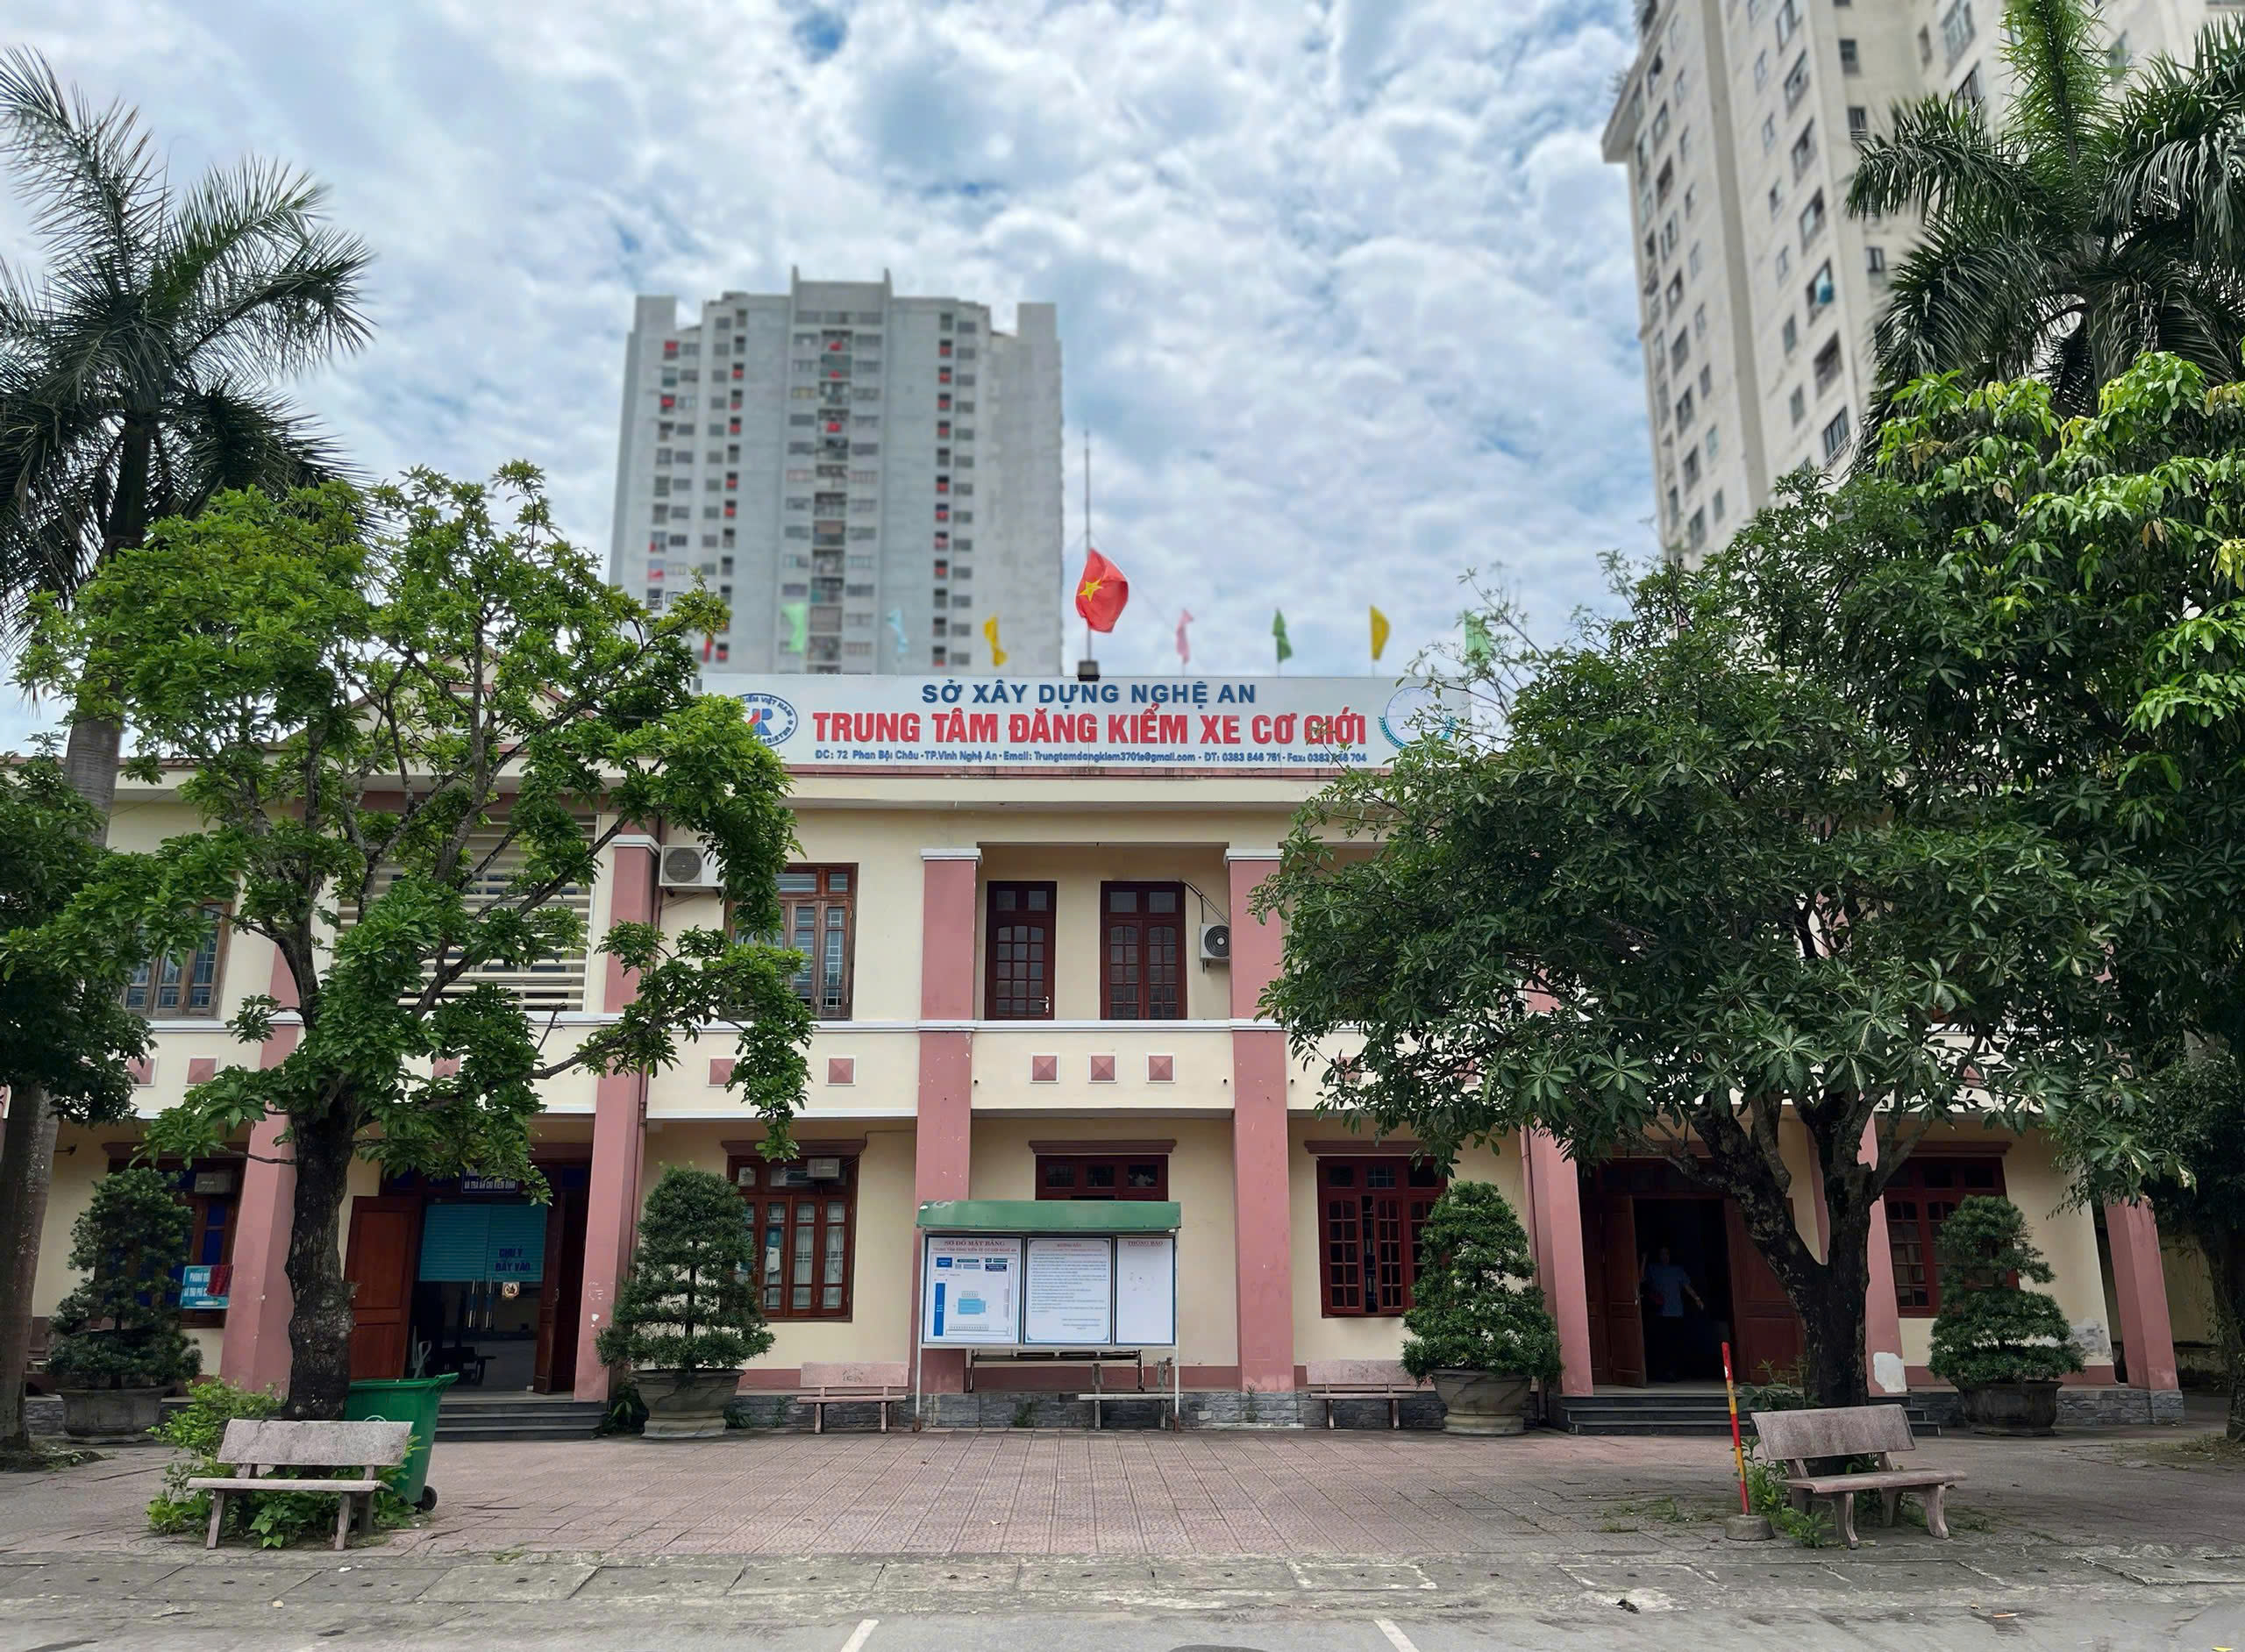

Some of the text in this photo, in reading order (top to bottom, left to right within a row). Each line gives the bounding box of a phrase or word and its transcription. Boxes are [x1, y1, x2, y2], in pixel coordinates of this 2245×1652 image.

[922, 680, 1256, 709] SỞ XÂY DỰNG NGHỆ AN
[812, 702, 1366, 744] TRUNG TÂM ĐĂNG KIỂM XE CƠ GIỚI
[837, 750, 848, 759] 72
[852, 750, 876, 759] Phan
[878, 750, 893, 761] Bội
[895, 750, 919, 760] Châu
[959, 751, 983, 763] Nghệ
[985, 751, 997, 760] An
[1003, 751, 1032, 760] Email:
[1287, 753, 1305, 762] Fax:
